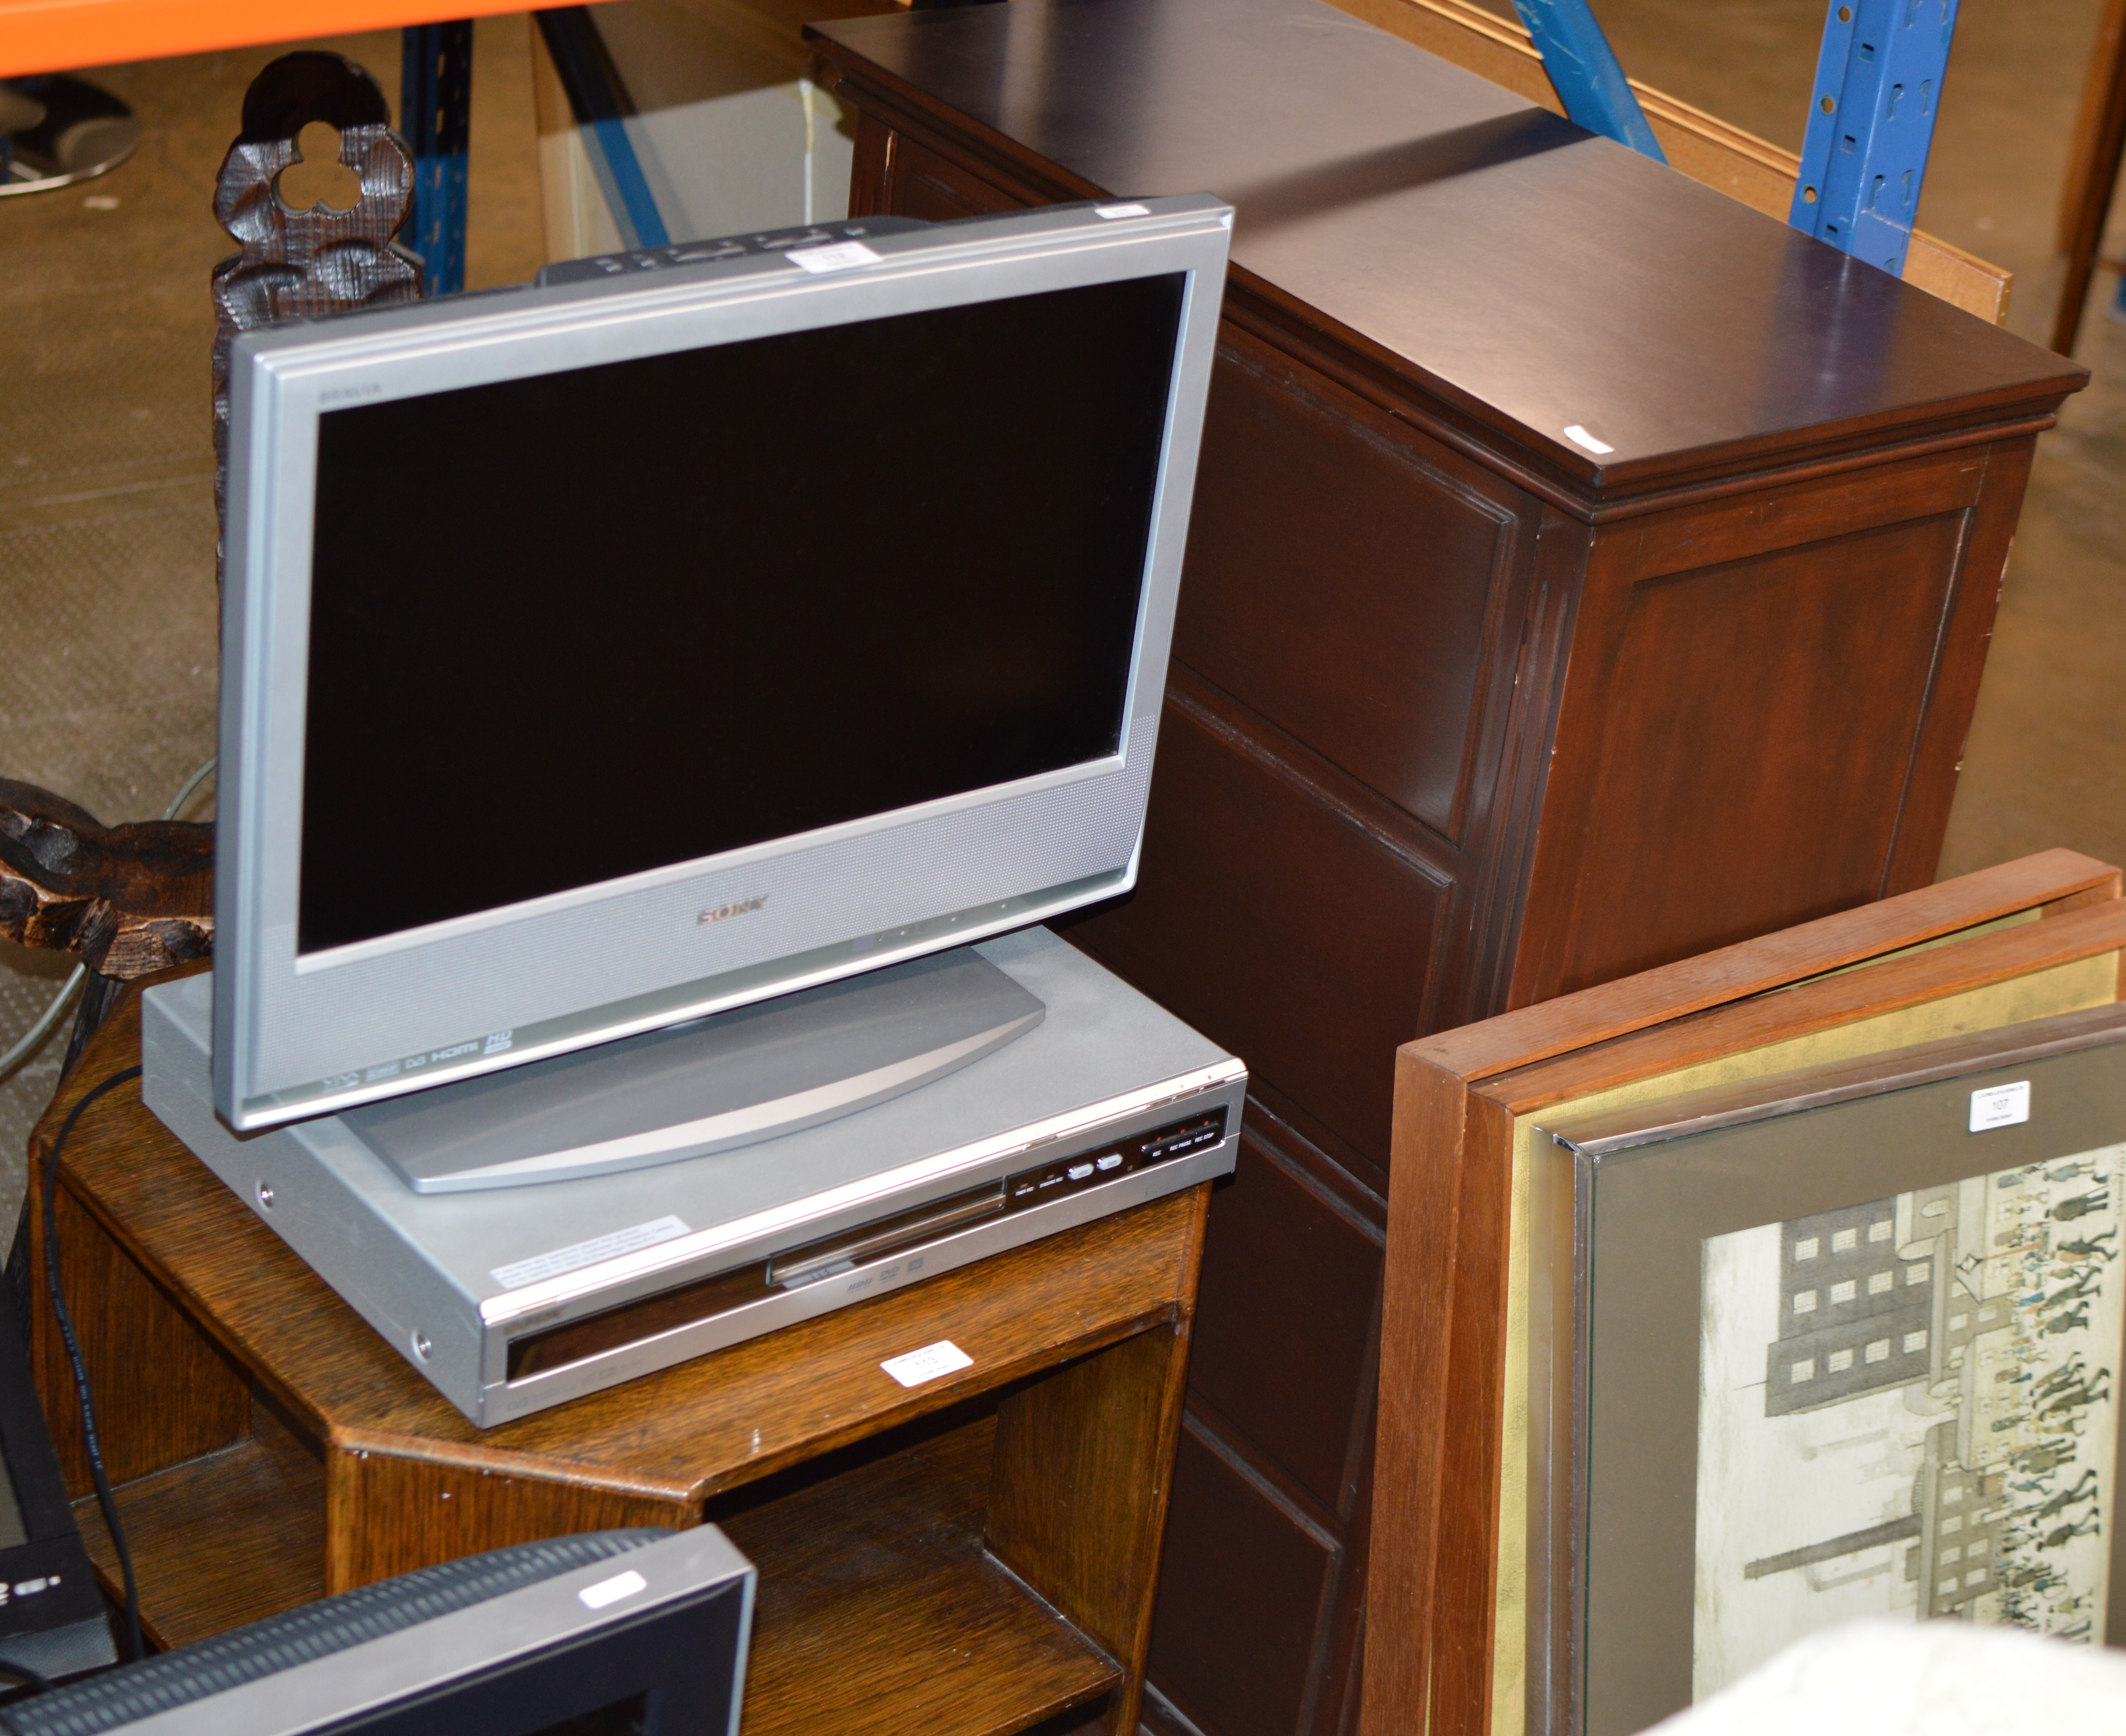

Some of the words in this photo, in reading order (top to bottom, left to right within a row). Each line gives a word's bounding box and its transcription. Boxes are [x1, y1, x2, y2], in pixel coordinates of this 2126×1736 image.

[486, 1030, 513, 1045] HD
[1992, 1098, 2010, 1111] 107
[1178, 1140, 1192, 1148] PAUSE
[847, 1277, 873, 1292] HDD
[915, 1357, 938, 1368] 113
